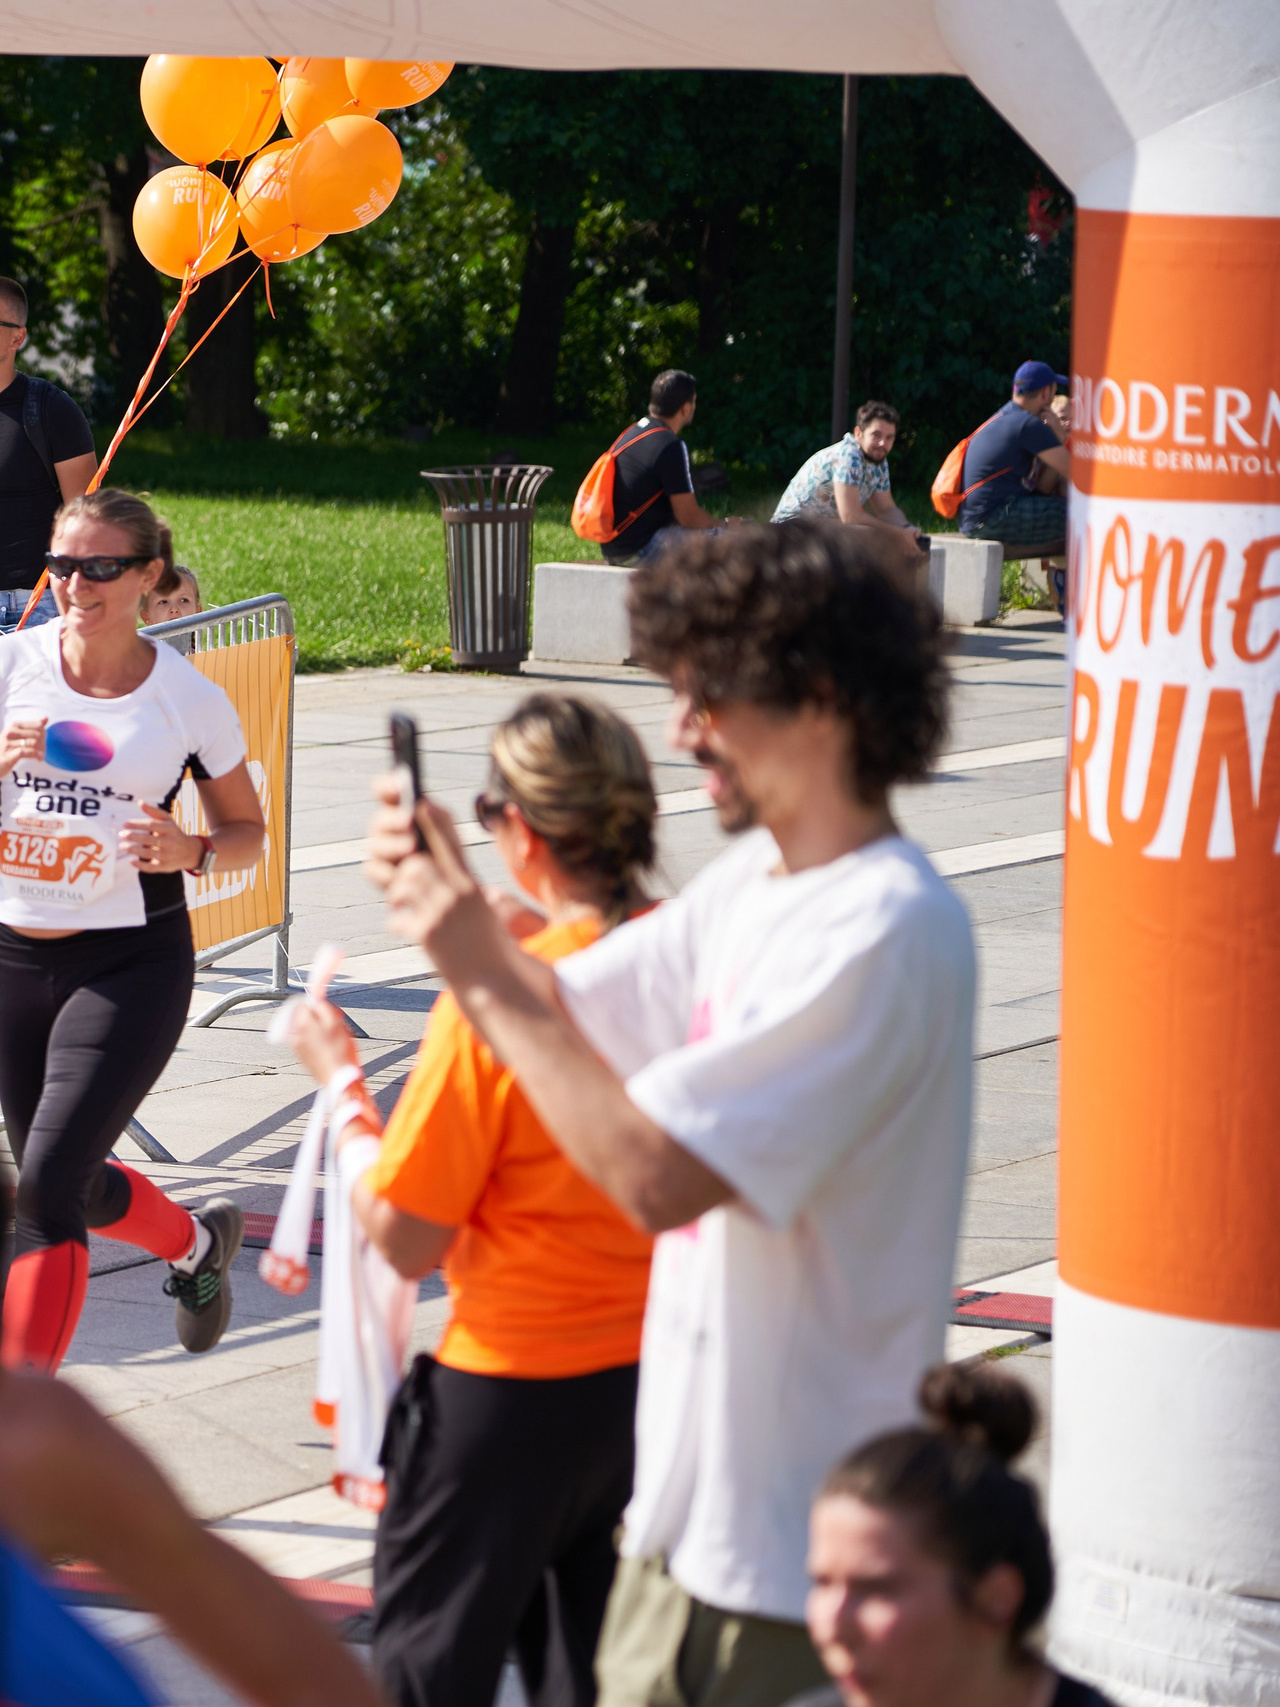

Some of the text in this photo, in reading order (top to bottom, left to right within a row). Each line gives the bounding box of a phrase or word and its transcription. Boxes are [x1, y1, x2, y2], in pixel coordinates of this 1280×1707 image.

[400, 65, 433, 94] RUN
[173, 187, 211, 205] RUN
[1153, 449, 1280, 476] DERMATOL
[36, 795, 100, 816] one
[3, 833, 59, 868] 3126
[20, 885, 84, 901] BIODERMA
